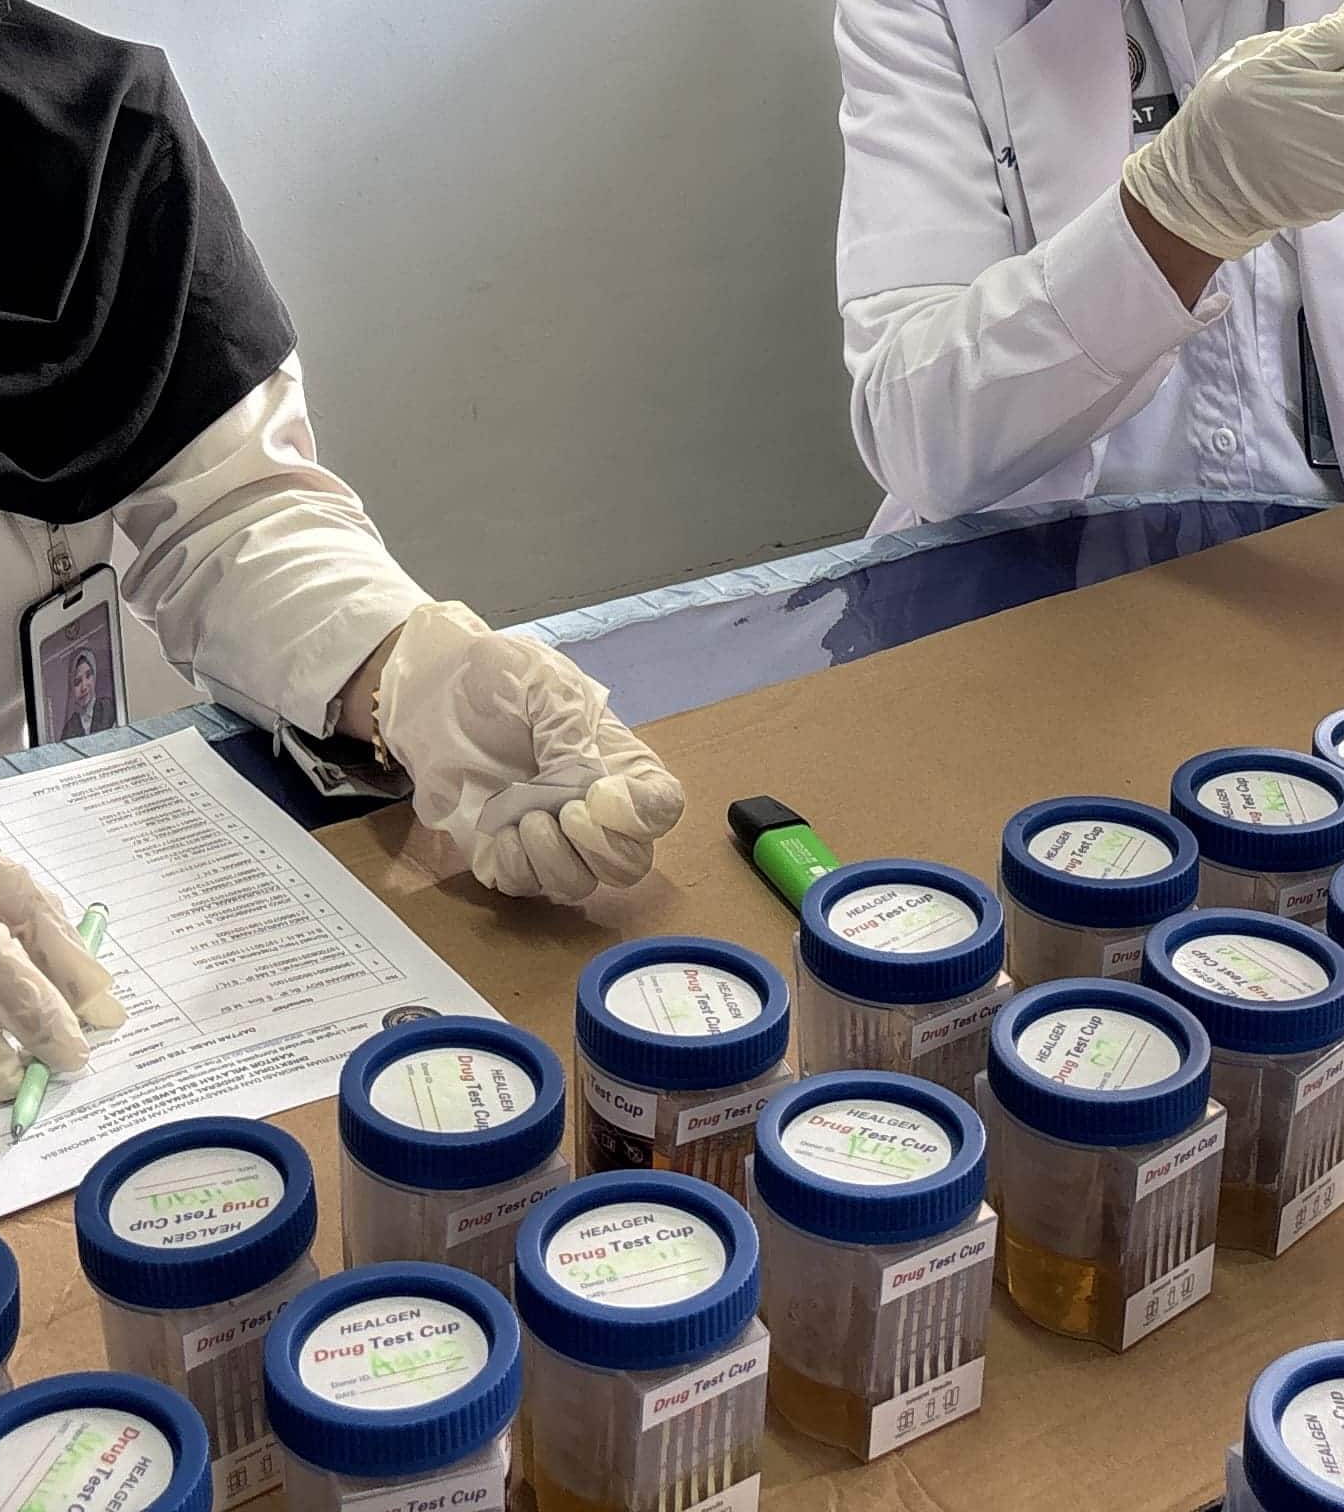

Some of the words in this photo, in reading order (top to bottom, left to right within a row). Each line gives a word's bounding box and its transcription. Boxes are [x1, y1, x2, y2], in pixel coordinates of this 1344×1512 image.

[1132, 106, 1154, 124] AT
[1216, 789, 1233, 818] EALGEN
[1086, 825, 1105, 842] Cup
[1071, 837, 1090, 861] Test
[1063, 853, 1082, 872] rug
[846, 890, 898, 918] HEALGEN
[1287, 892, 1313, 907] Drug
[1316, 888, 1328, 899] Te
[842, 918, 880, 937] Drug
[879, 905, 906, 922] Test
[906, 892, 934, 908] Cup
[1111, 949, 1141, 964] Drug
[1191, 948, 1213, 961] Cup
[1217, 966, 1246, 989] Test
[684, 969, 698, 993] Drug
[696, 992, 713, 1016] Test
[717, 981, 744, 1019] HEALGEN
[1247, 984, 1274, 1001] rug
[216, 1027, 257, 1042] DAFTAR
[921, 1024, 950, 1043] Drug
[952, 1011, 978, 1030] Test
[979, 1003, 1003, 1019] Cup
[186, 1039, 217, 1051] HASIL
[1035, 1022, 1067, 1063] HEALGEN
[1067, 1032, 1092, 1060] Test
[1080, 1014, 1103, 1038] Cup
[135, 1055, 167, 1069] URINE
[166, 1049, 186, 1058] TES
[246, 1055, 308, 1076] DIREKTORAT
[249, 1051, 294, 1068] KANTOR
[195, 1074, 246, 1093] JENDERAL
[197, 1065, 248, 1084] WILAYAH
[239, 1078, 261, 1087] DAN
[458, 1055, 473, 1082] Drug
[466, 1083, 484, 1113] Test
[1302, 1074, 1323, 1097] Drug
[1325, 1059, 1344, 1081] Test
[140, 1082, 198, 1104] SULAWESI
[491, 1068, 515, 1112] HEALGEN
[590, 1073, 612, 1104] Test
[614, 1096, 644, 1118] Cup
[96, 1091, 194, 1129] PEMASYARAKATAN
[101, 1103, 140, 1120] BARAT
[687, 1113, 721, 1131] Drug
[724, 1102, 752, 1121] Test
[846, 1108, 922, 1132] HEALGEN
[808, 1115, 854, 1135] Drug
[857, 1126, 898, 1144] Test
[900, 1136, 938, 1154] Cup
[40, 1136, 97, 1160] INDONESIA
[1144, 1162, 1171, 1185] Drug
[1173, 1146, 1196, 1170] Test
[1198, 1132, 1218, 1154] Cup
[174, 1208, 218, 1224] Test
[222, 1197, 271, 1214] Drug
[458, 1212, 493, 1233] Drug
[497, 1198, 527, 1218] Test
[129, 1217, 169, 1232] Cup
[162, 1222, 242, 1245] HEALGEN
[580, 1214, 656, 1240] HEALGEN
[559, 1246, 606, 1266] Drug
[609, 1234, 651, 1254] Test
[656, 1224, 695, 1242] Cup
[891, 1266, 925, 1289] Drug
[928, 1250, 957, 1274] Test
[959, 1240, 986, 1260] Cup
[197, 1327, 235, 1353] Drug
[240, 1310, 273, 1334] Test
[339, 1308, 422, 1335] HEALGEN
[314, 1343, 365, 1364] Drug
[369, 1332, 414, 1350] Test
[420, 1320, 461, 1339] Cup
[653, 1389, 690, 1413] Drug
[693, 1371, 725, 1395] Test
[728, 1357, 757, 1378] Cup
[101, 1426, 140, 1466] Drug
[1304, 1414, 1341, 1475] HEALGEN
[77, 1467, 114, 1502] Test
[107, 1456, 153, 1512] HEALGE
[451, 1488, 488, 1504] Cup
